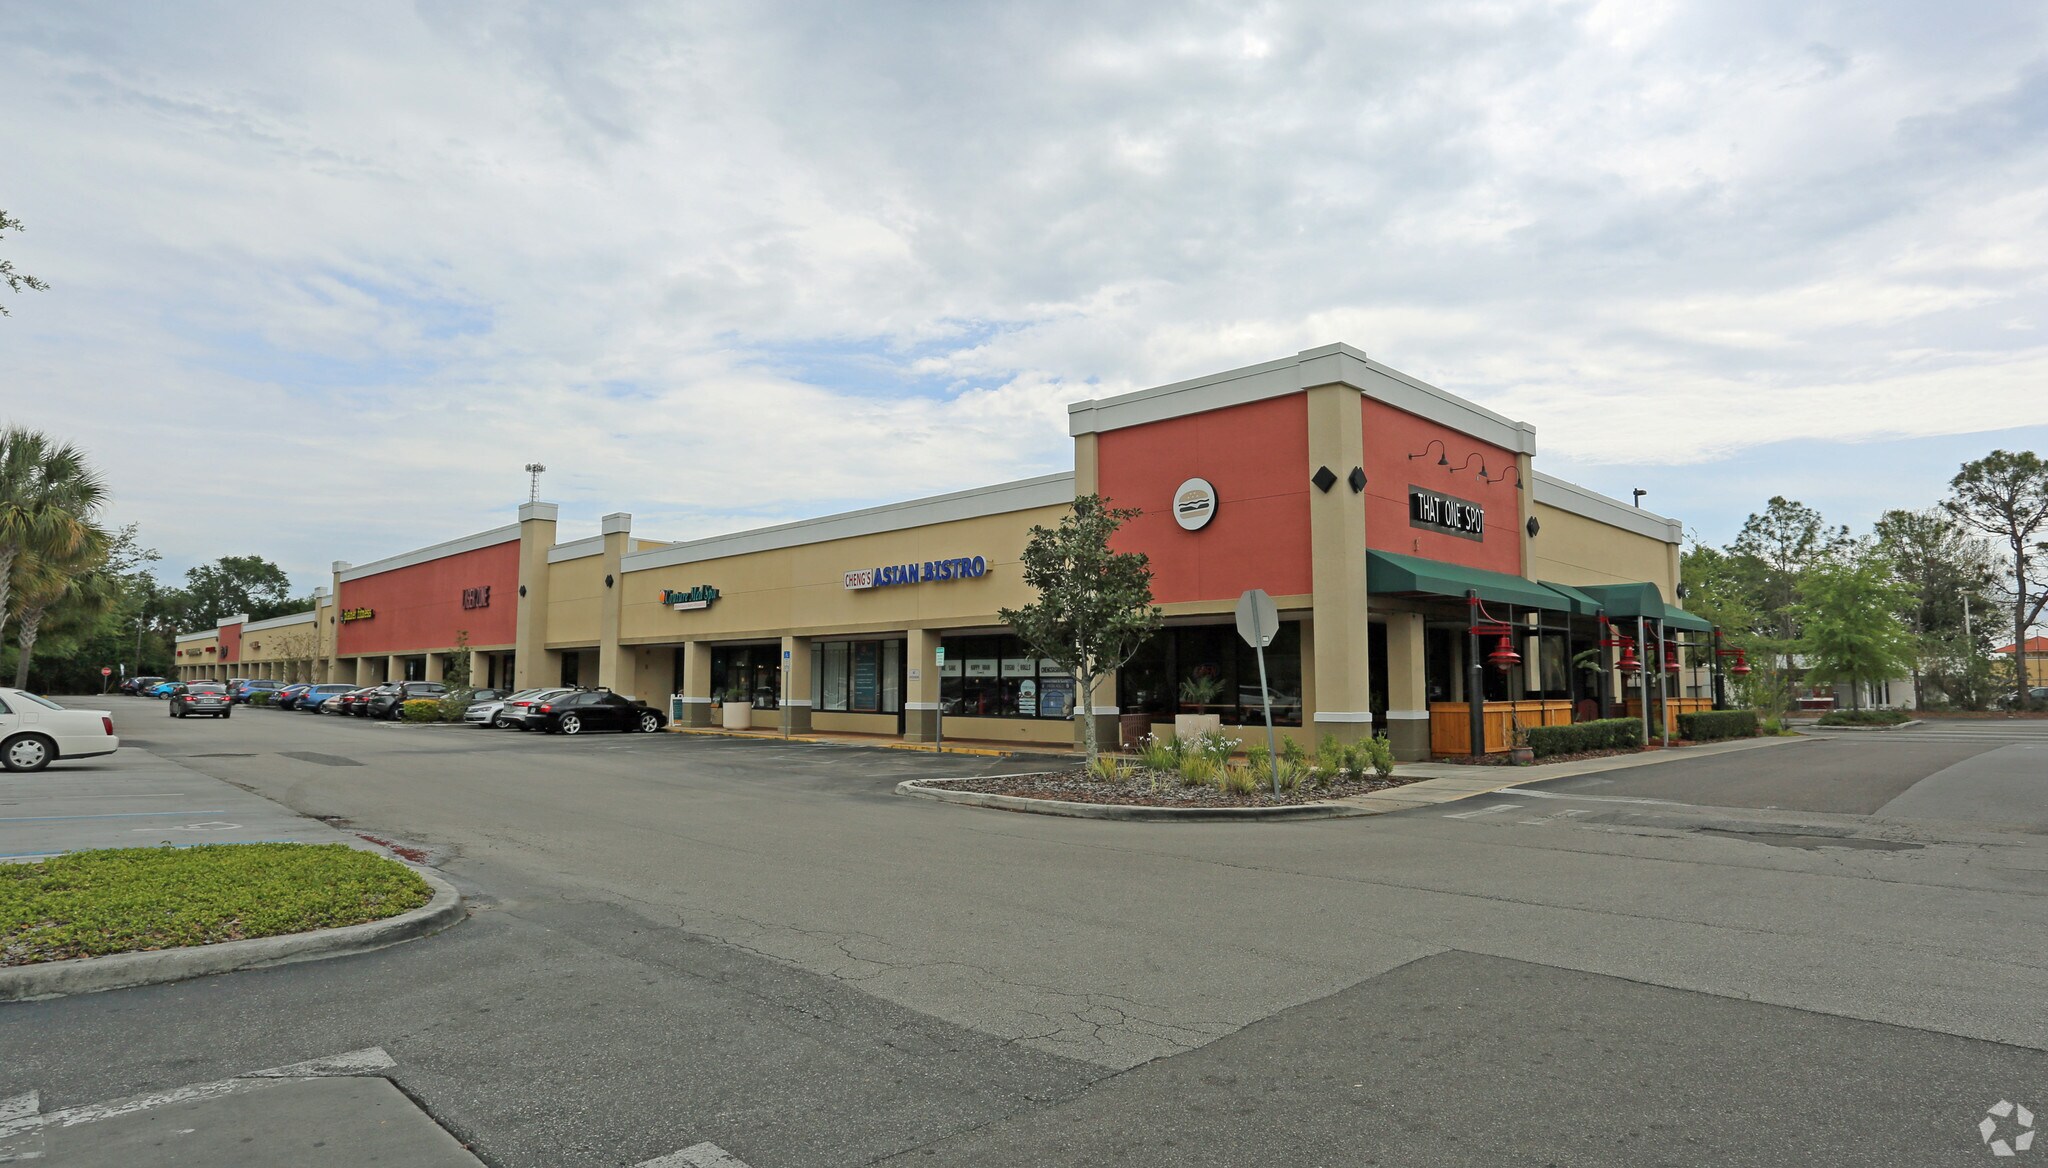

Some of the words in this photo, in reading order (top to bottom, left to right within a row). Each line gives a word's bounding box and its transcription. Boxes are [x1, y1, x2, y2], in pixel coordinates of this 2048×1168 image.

[1417, 492, 1440, 523] THAT
[1444, 500, 1461, 528] ONE
[1465, 505, 1485, 533] SPOT
[845, 570, 872, 588] CHENG'S
[873, 562, 919, 587] ASIAN
[923, 555, 986, 582] BISTRO
